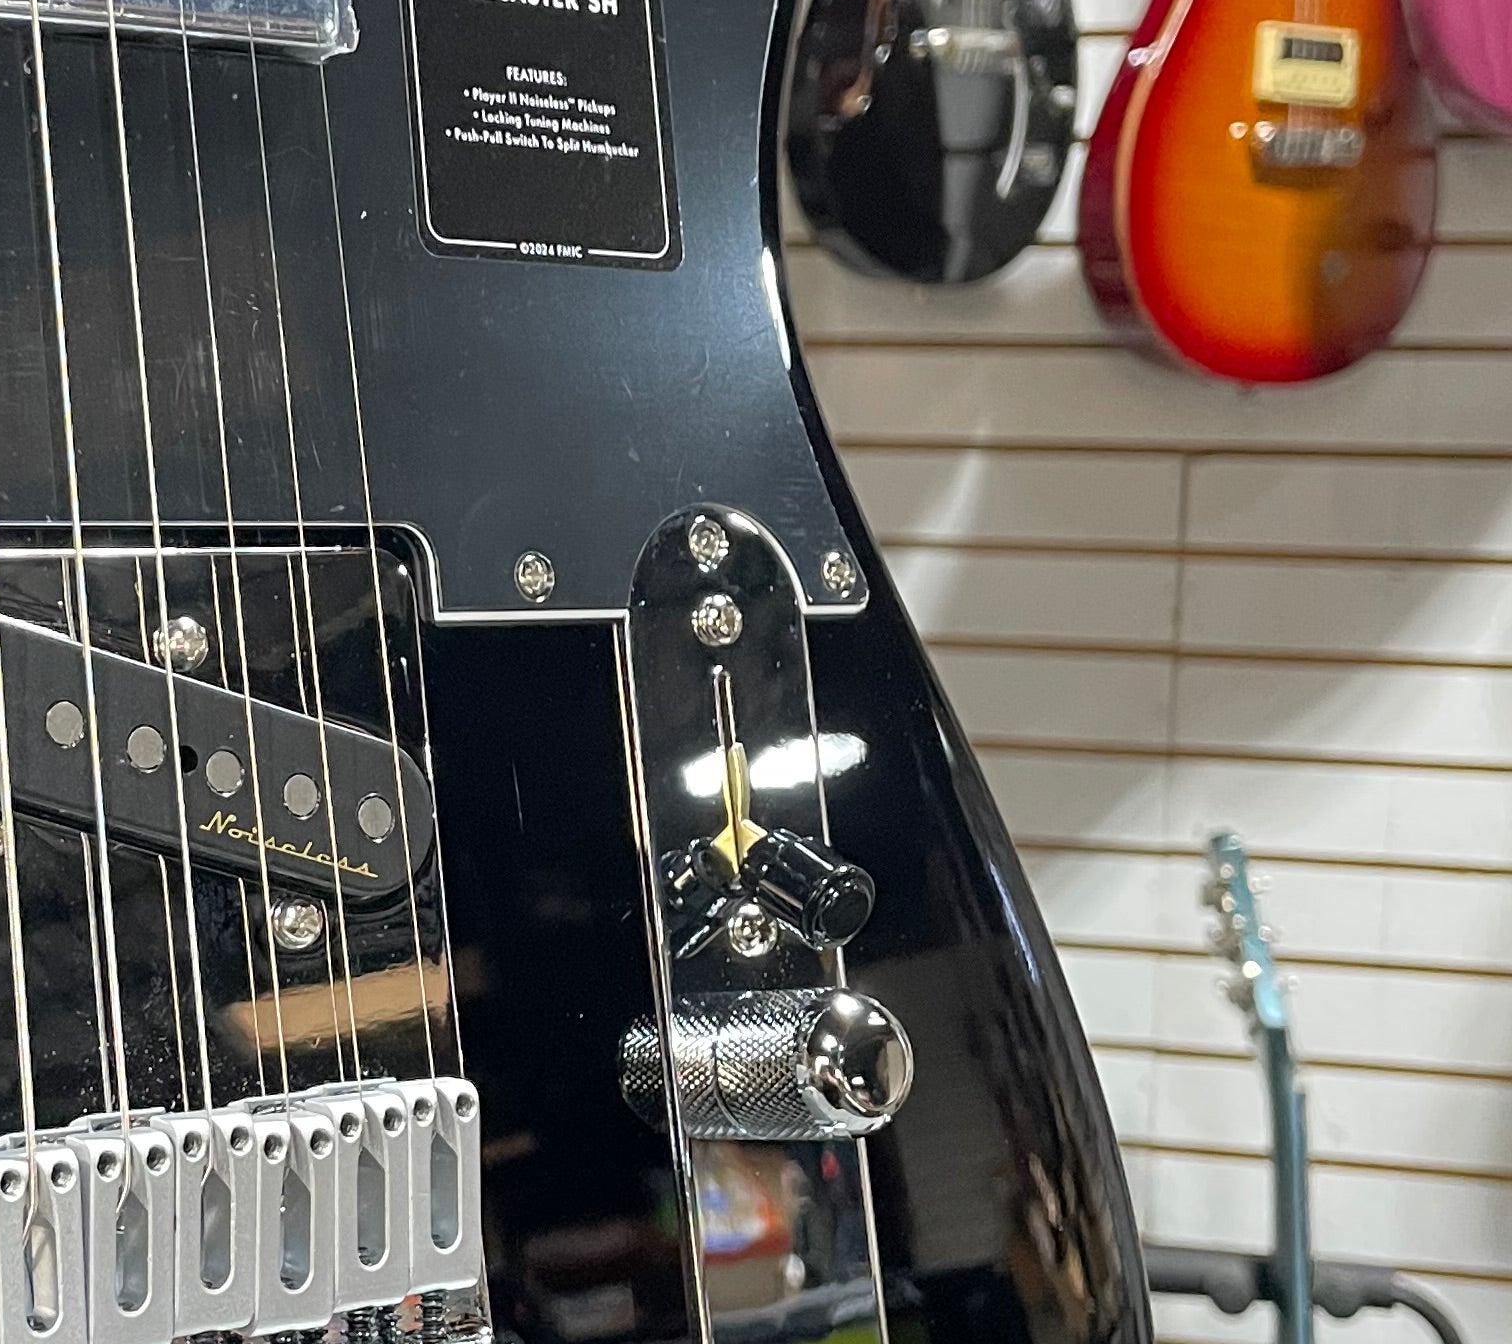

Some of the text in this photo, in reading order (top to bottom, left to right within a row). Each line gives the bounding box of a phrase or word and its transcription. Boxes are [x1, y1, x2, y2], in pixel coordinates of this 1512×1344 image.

[505, 65, 568, 87] FEATURES:
[472, 86, 507, 106] Player
[508, 91, 518, 105] II
[577, 98, 616, 118] Pickups
[481, 108, 611, 135] Locking Tuning Machines
[453, 126, 639, 158] Push-Pull Switch To Split Humbucker
[556, 244, 583, 259] FMIC
[199, 810, 379, 878] Noiseless
